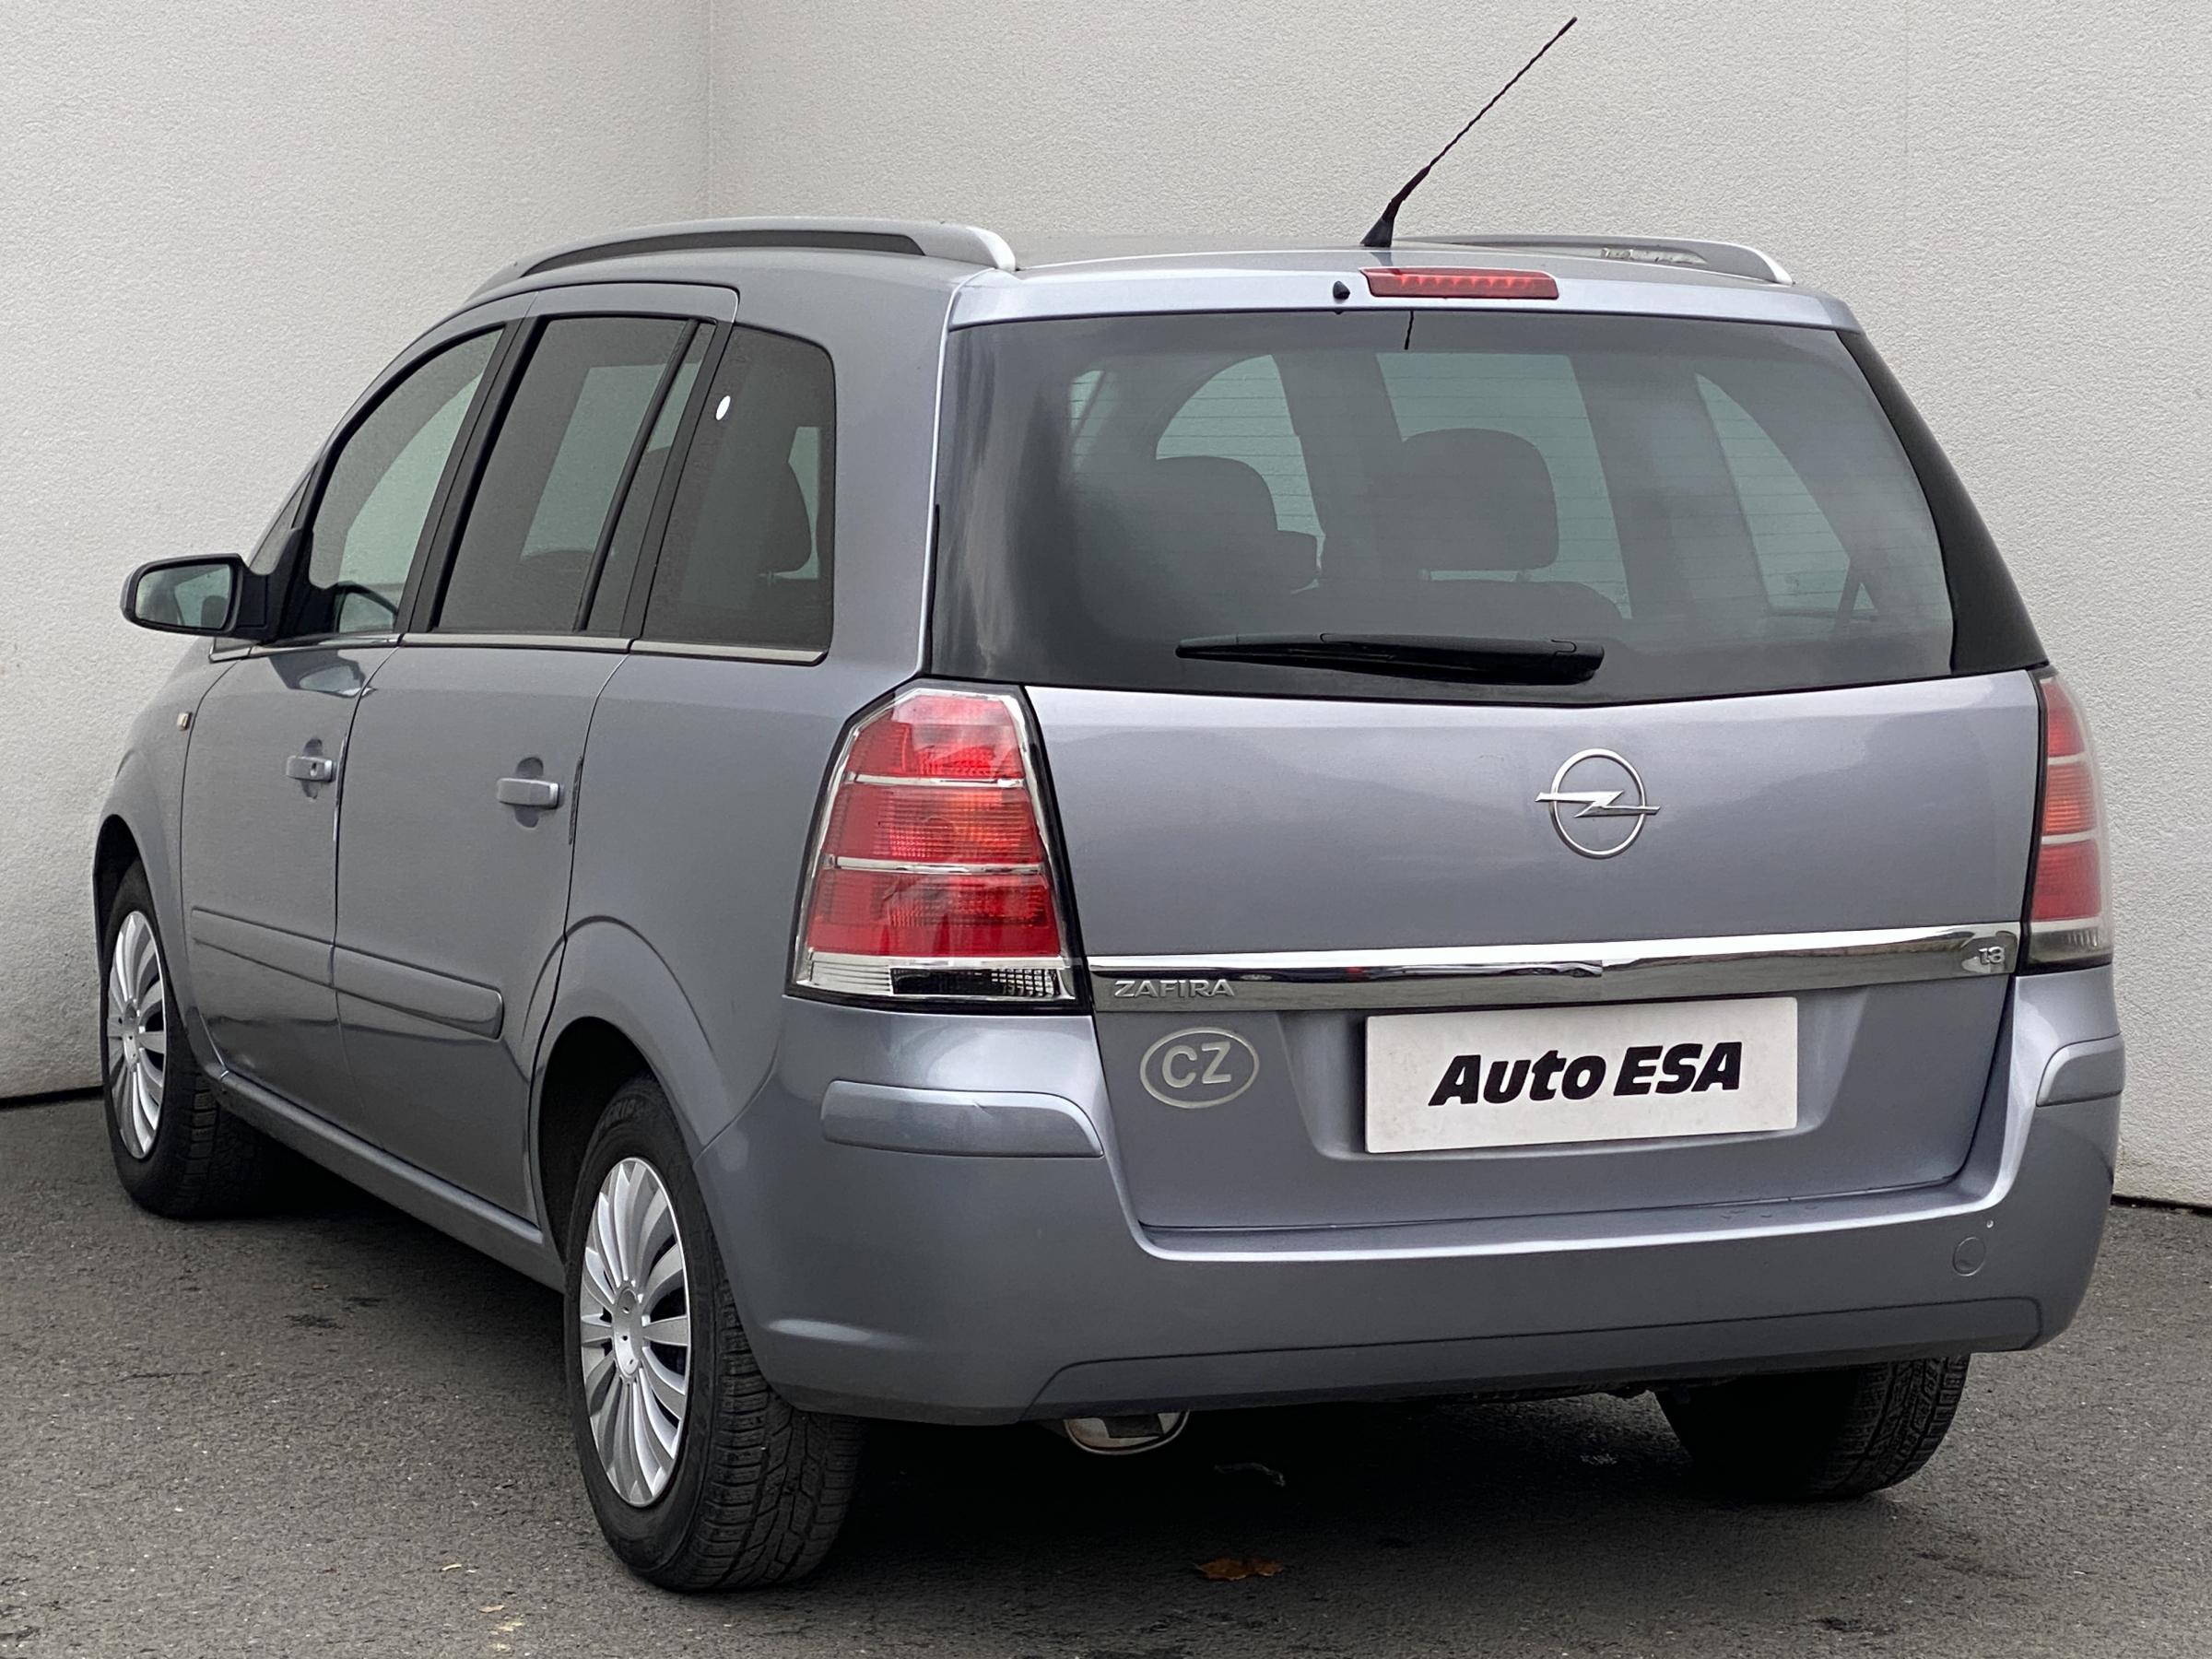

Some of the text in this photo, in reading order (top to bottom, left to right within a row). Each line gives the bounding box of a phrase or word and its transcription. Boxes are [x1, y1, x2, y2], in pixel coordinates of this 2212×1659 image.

[1114, 979, 1235, 998] ZAFIRA
[1162, 1041, 1231, 1088] CZ
[1428, 1041, 1743, 1106] Auto ESA
